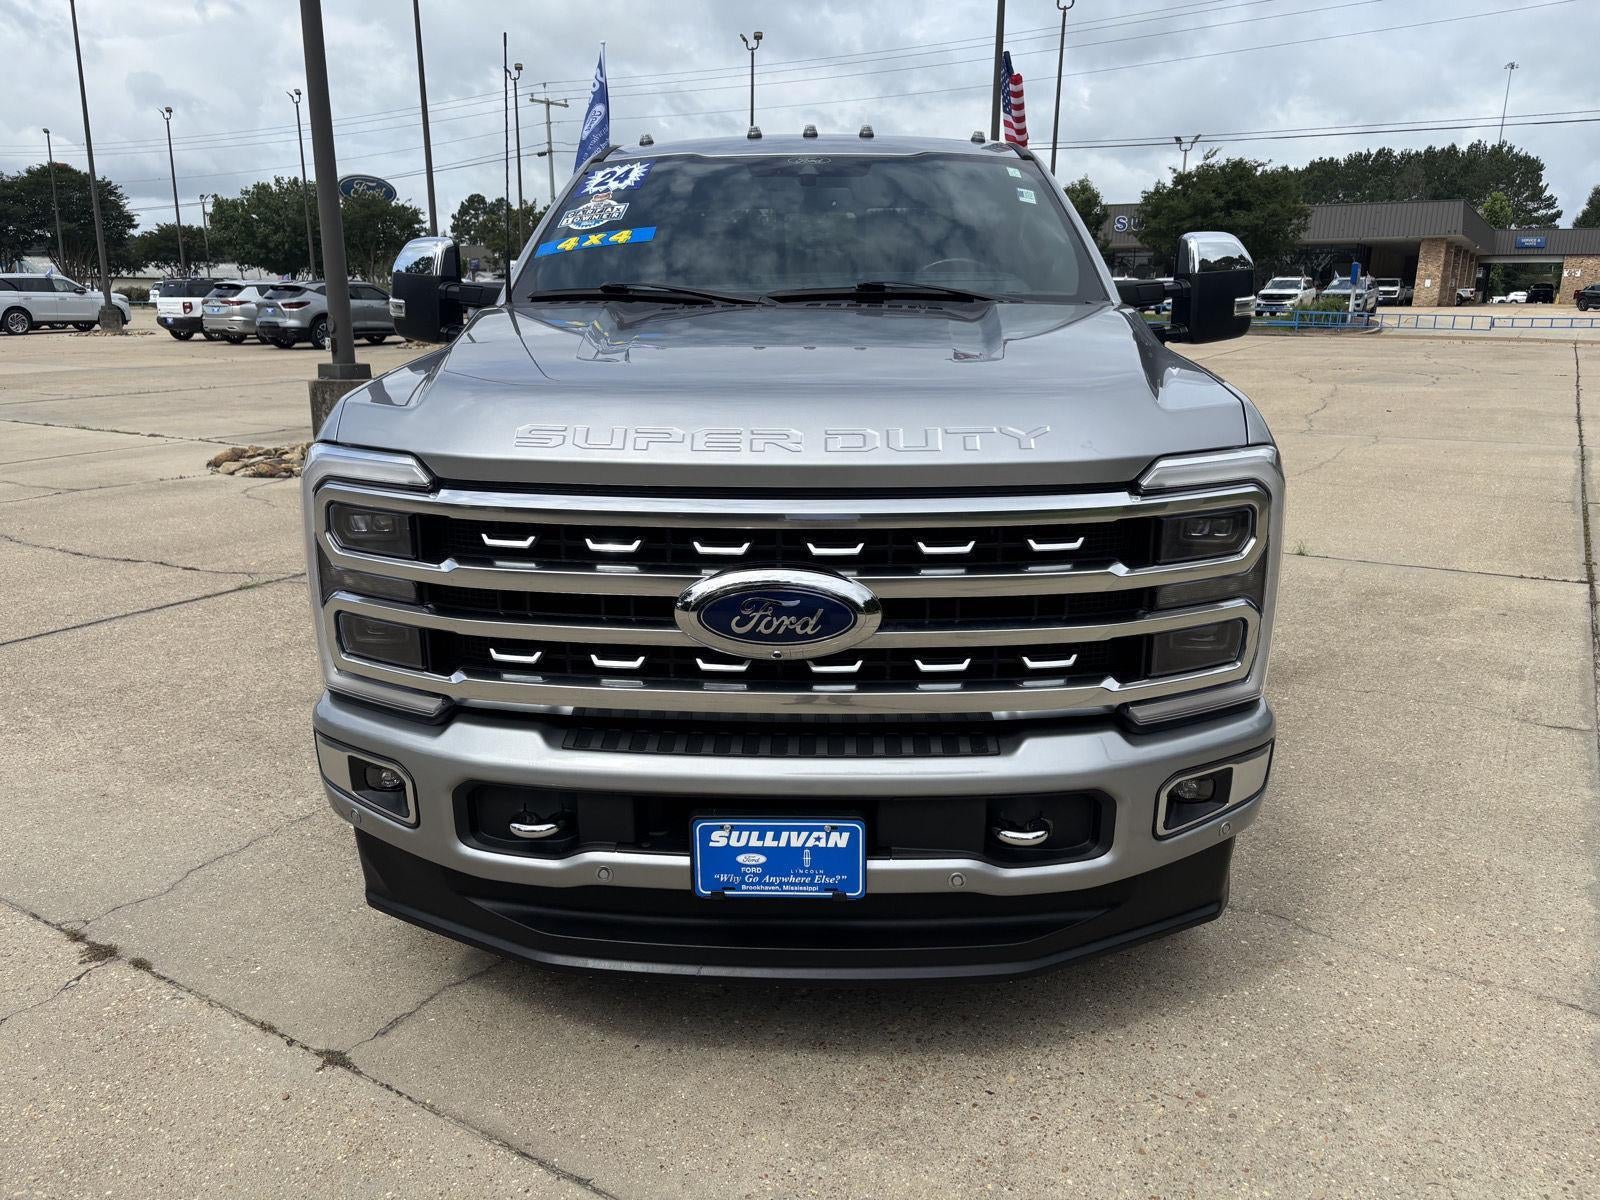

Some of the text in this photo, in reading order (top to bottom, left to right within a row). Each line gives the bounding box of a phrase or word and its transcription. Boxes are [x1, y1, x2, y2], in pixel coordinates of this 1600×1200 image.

[592, 166, 636, 188] 24
[567, 206, 623, 218] CARFAX
[573, 212, 620, 223] OWNER
[514, 424, 1051, 453] SUPER DUTY
[731, 597, 824, 635] Ford
[708, 830, 850, 848] SULLIVAN
[742, 855, 761, 864] Ford
[744, 874, 759, 883] Go
[763, 875, 812, 885] Anywhere
[741, 884, 782, 892] Brookhaven,
